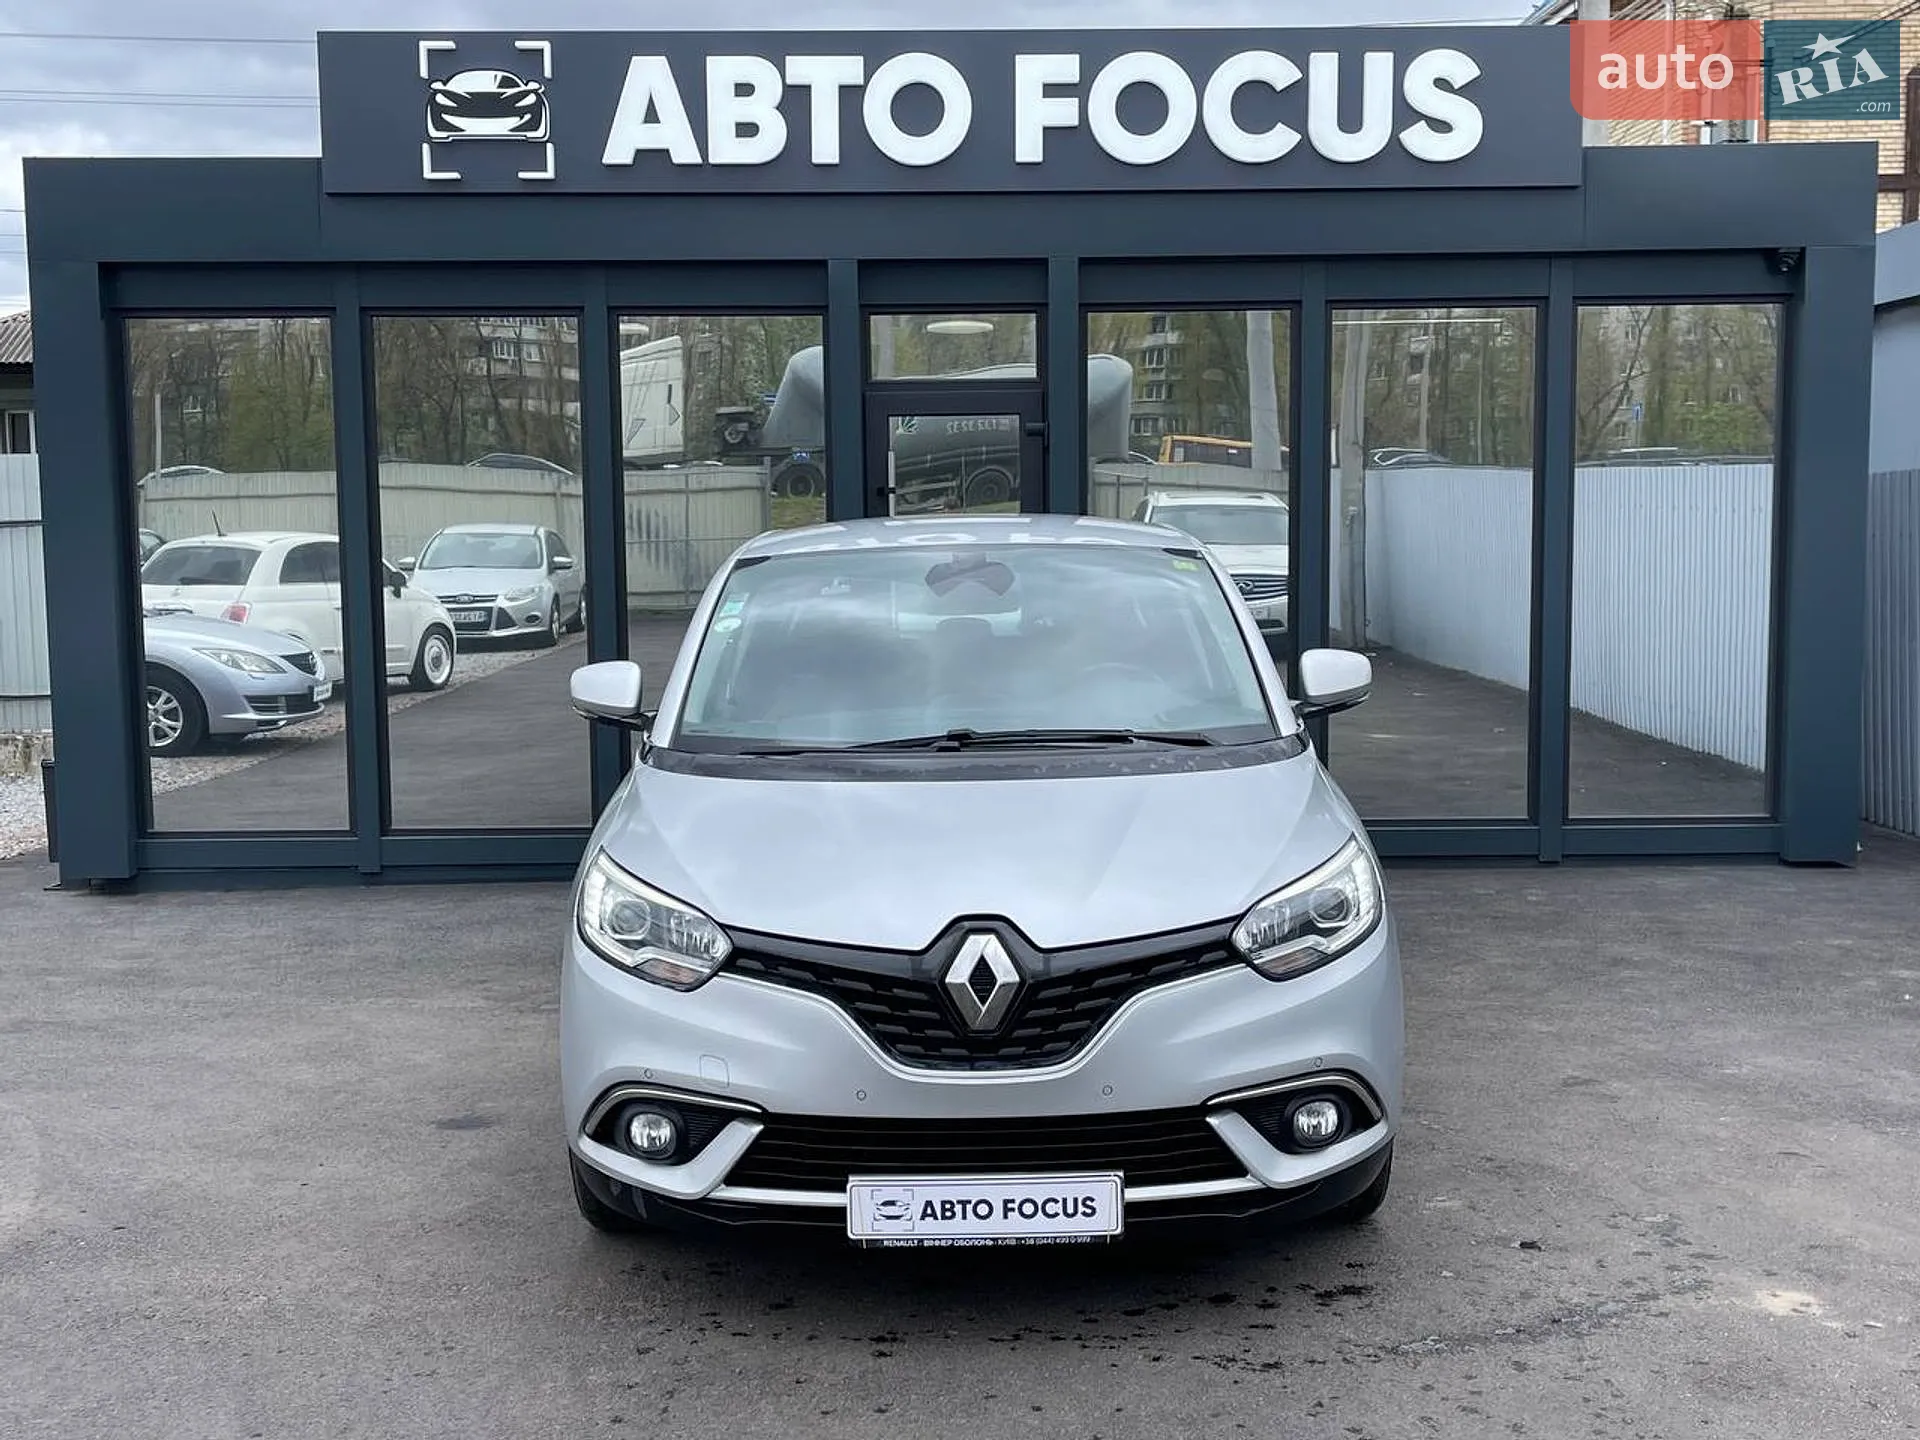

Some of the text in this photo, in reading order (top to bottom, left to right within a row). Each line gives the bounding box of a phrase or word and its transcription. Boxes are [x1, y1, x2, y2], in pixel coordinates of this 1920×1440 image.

[602, 49, 1484, 166] АВТО FOCUS
[919, 1195, 1098, 1221] АВТО FOCUS
